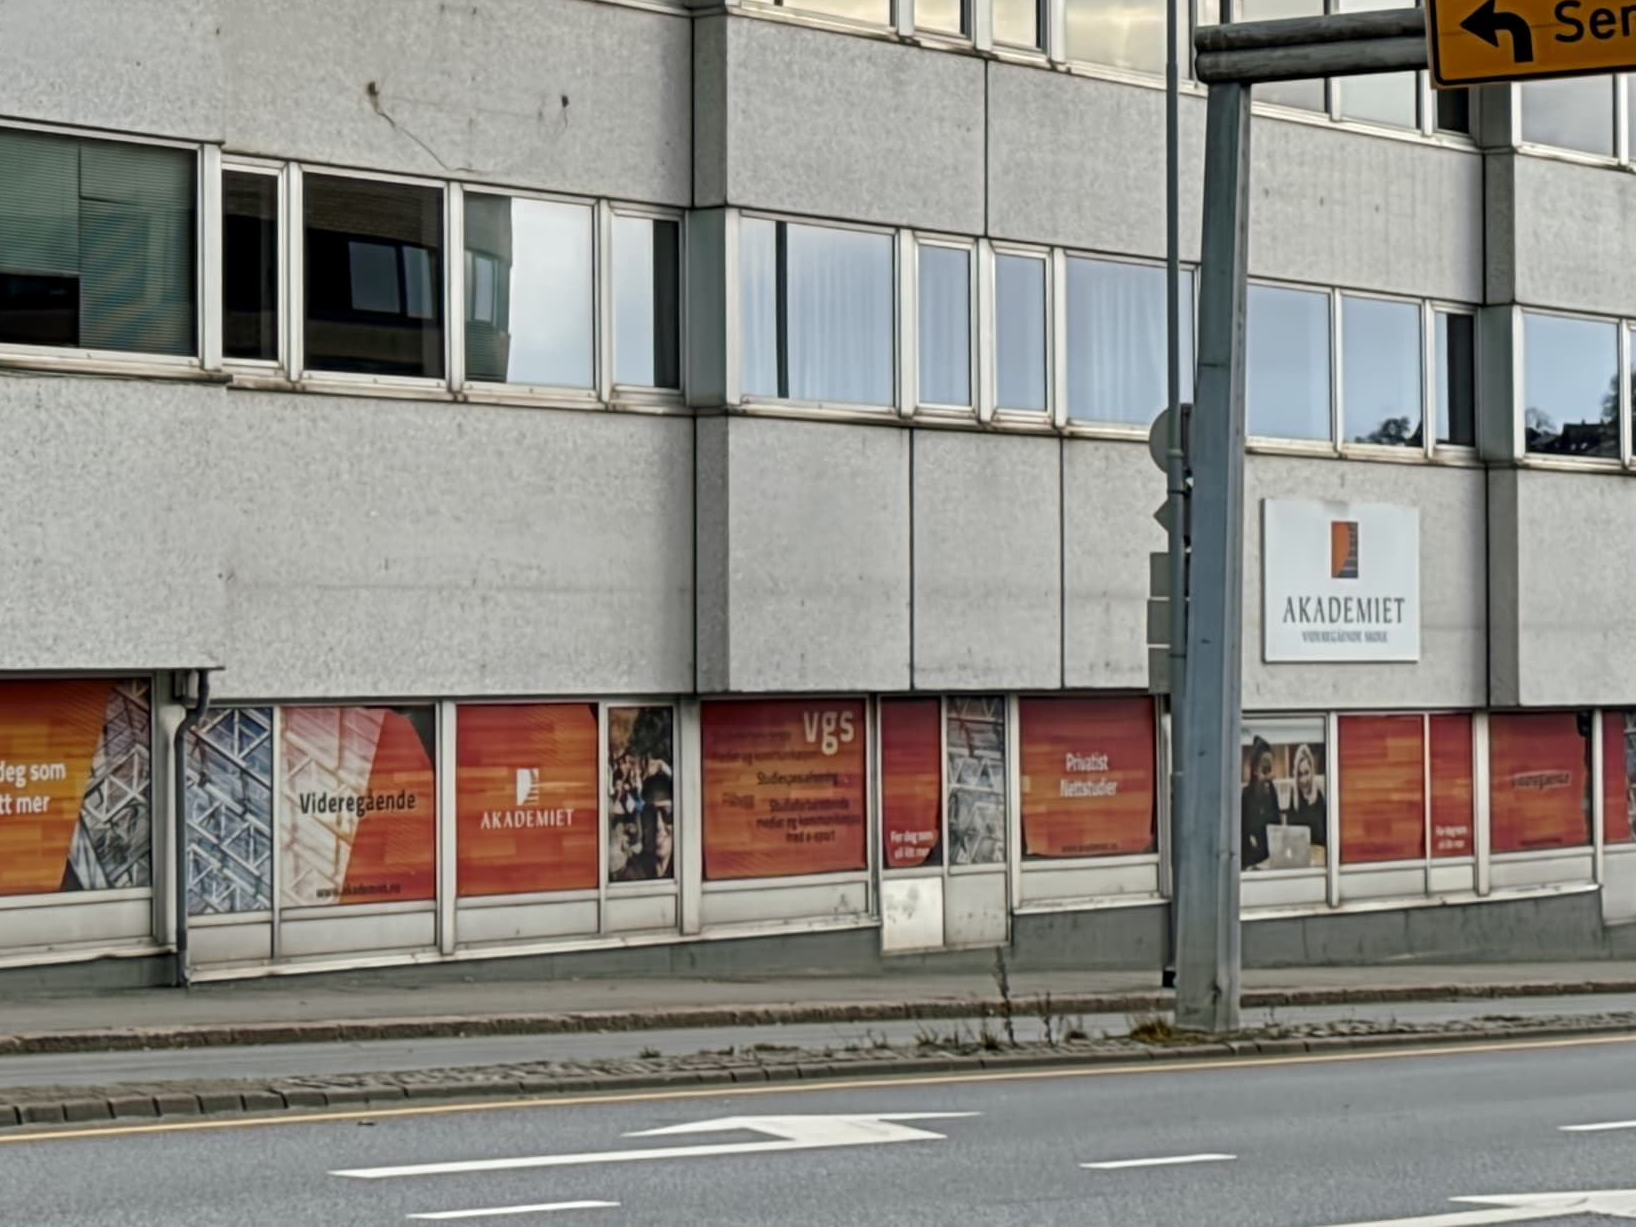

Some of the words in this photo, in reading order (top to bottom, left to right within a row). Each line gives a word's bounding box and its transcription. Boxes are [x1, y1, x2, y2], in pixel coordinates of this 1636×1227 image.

[1283, 595, 1405, 624] AKADEMIET
[803, 710, 855, 755] vgs
[29, 762, 66, 782] som
[16, 795, 51, 815] mer
[300, 790, 416, 817] Videregående
[480, 808, 575, 830] AKADEMIET
